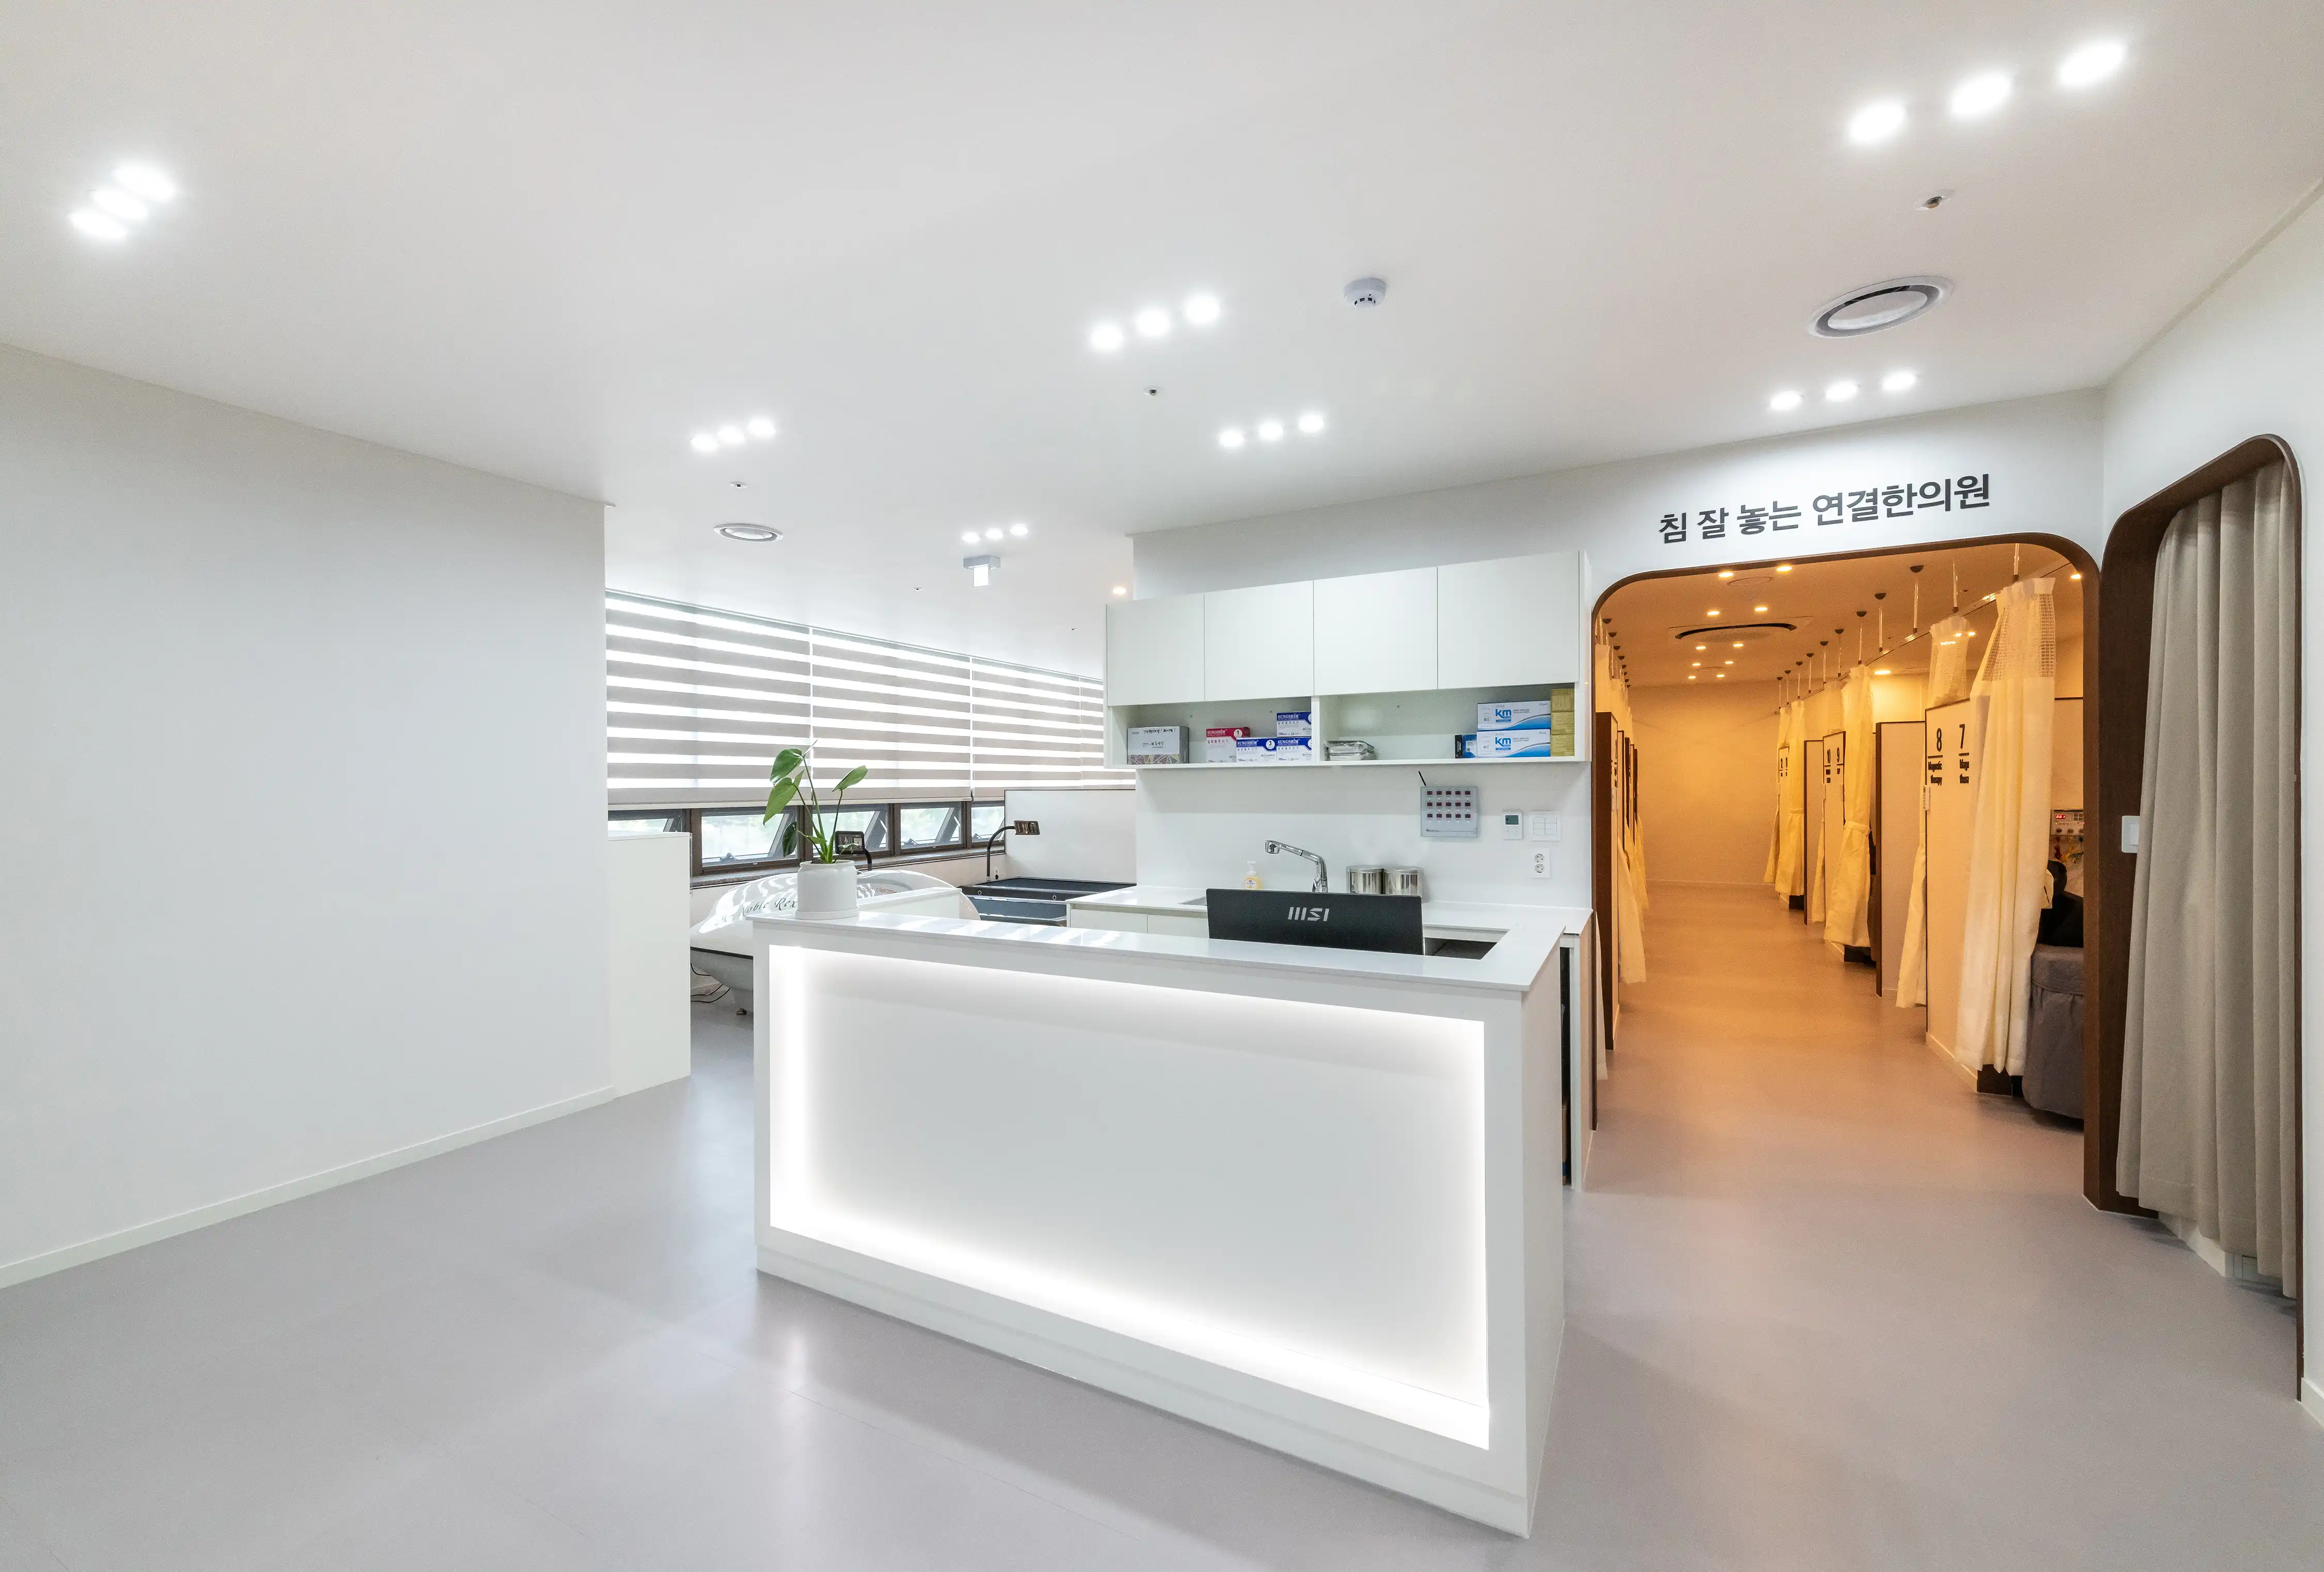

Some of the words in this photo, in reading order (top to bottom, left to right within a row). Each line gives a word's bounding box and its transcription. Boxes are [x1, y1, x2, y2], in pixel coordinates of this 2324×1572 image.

[1659, 513, 1687, 544] 침
[1697, 508, 1729, 540] 잘
[1737, 500, 1801, 535] 놓는
[1813, 474, 1990, 526] 연결한의원
[1936, 728, 1942, 752] 8
[1959, 724, 1965, 749] 7
[1836, 747, 1840, 762] 9
[1287, 907, 1330, 922] MSI
